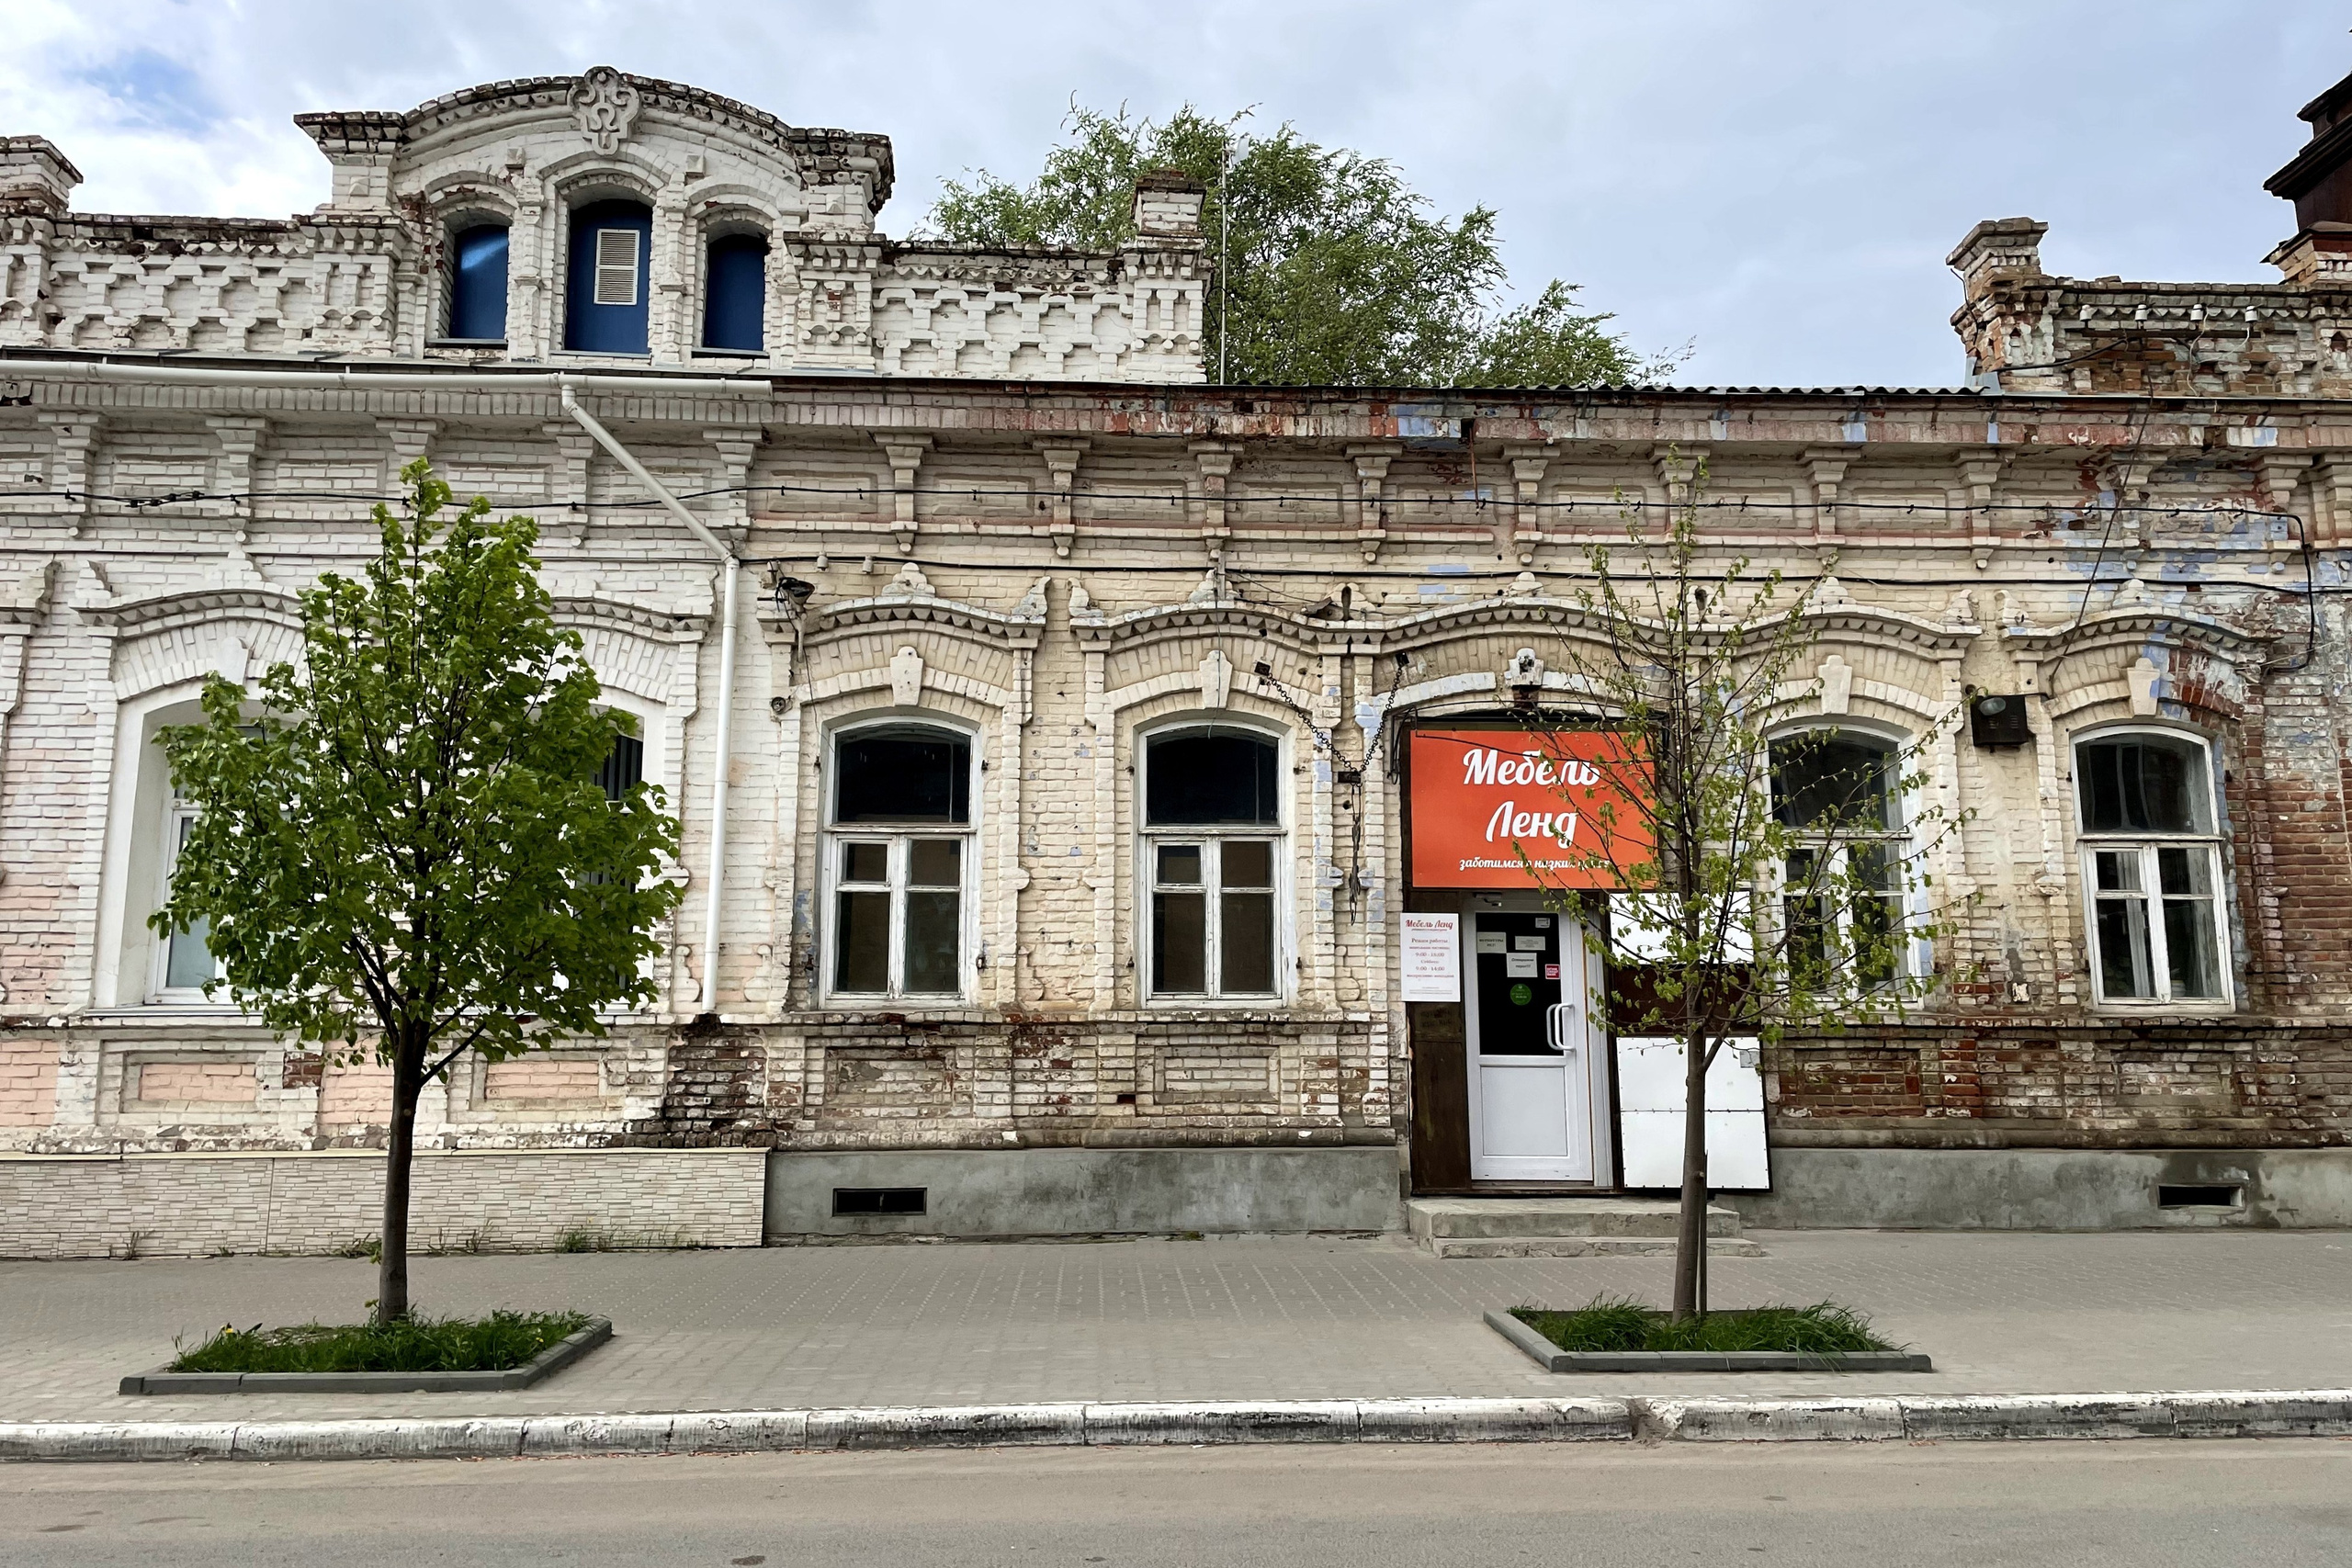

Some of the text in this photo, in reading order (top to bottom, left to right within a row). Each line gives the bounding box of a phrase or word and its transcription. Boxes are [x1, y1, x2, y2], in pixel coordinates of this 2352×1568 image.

[1463, 749, 1600, 785] Мебель
[1486, 801, 1578, 850] Ленд
[1459, 856, 1523, 871] заботимся
[1406, 919, 1453, 931] Мебель Ленд
